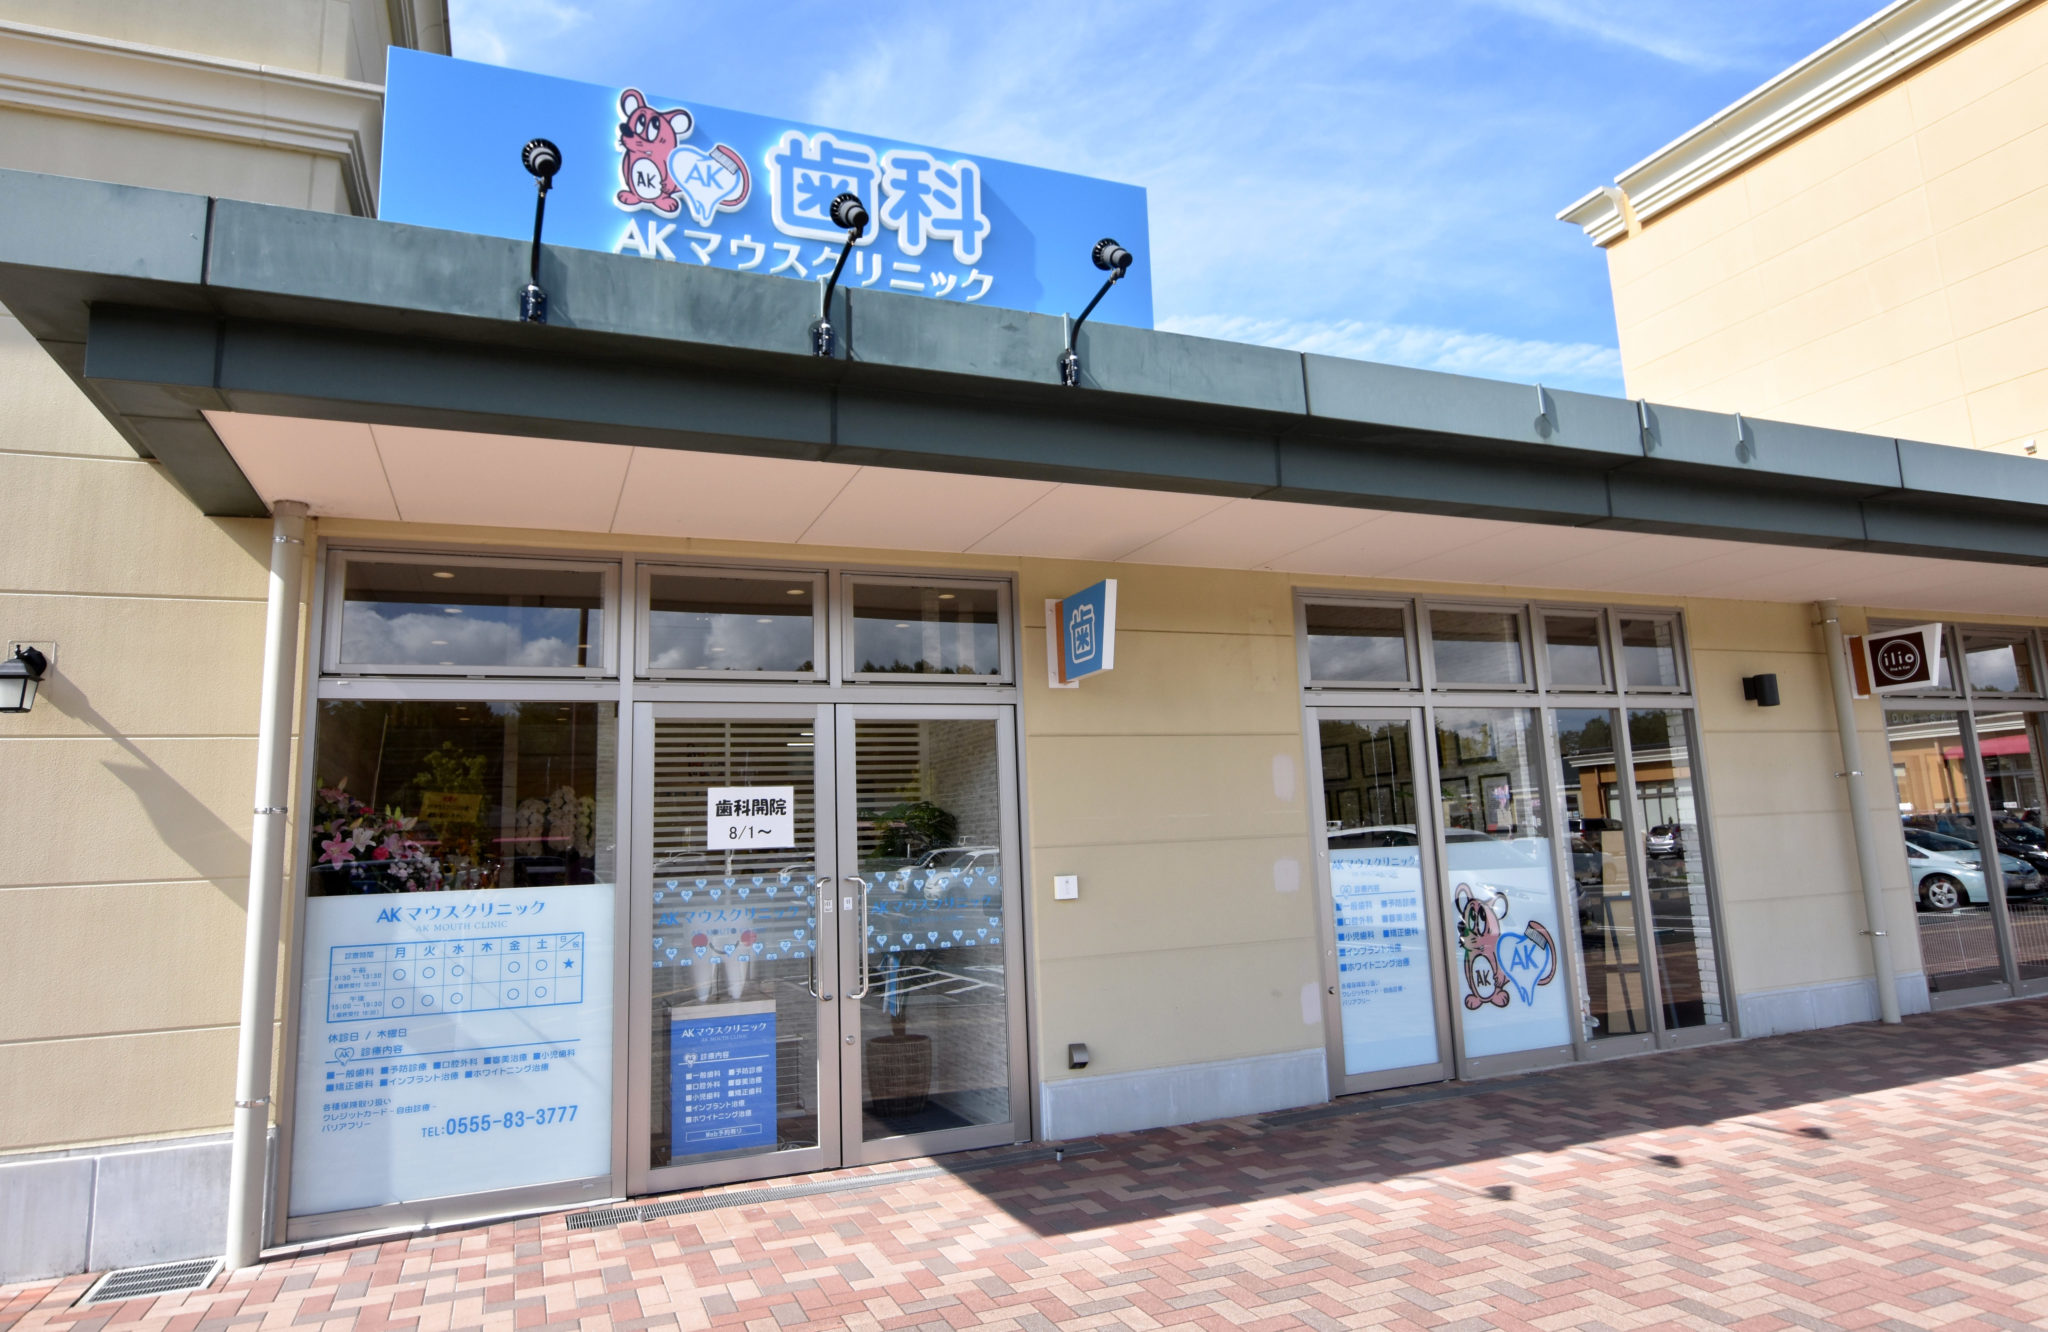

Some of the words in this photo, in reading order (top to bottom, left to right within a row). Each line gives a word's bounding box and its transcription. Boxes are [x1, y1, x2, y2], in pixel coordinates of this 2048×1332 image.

[636, 170, 657, 190] AK
[684, 161, 724, 190] AK
[767, 132, 990, 265] 歯科
[1070, 603, 1095, 664] 歯
[1883, 651, 1914, 666] ilio
[715, 798, 787, 817] 歯科開院
[415, 923, 430, 933] AK
[434, 922, 471, 932] MOUTH
[474, 920, 508, 929] CLINIC
[394, 947, 406, 959] 月
[423, 945, 436, 957] 火
[452, 944, 464, 955] 水
[481, 942, 493, 952] 木
[508, 940, 521, 951] 金
[537, 939, 548, 949] 土
[1510, 944, 1539, 971] AK
[1475, 969, 1493, 987] AK
[328, 1032, 359, 1043] 休診日
